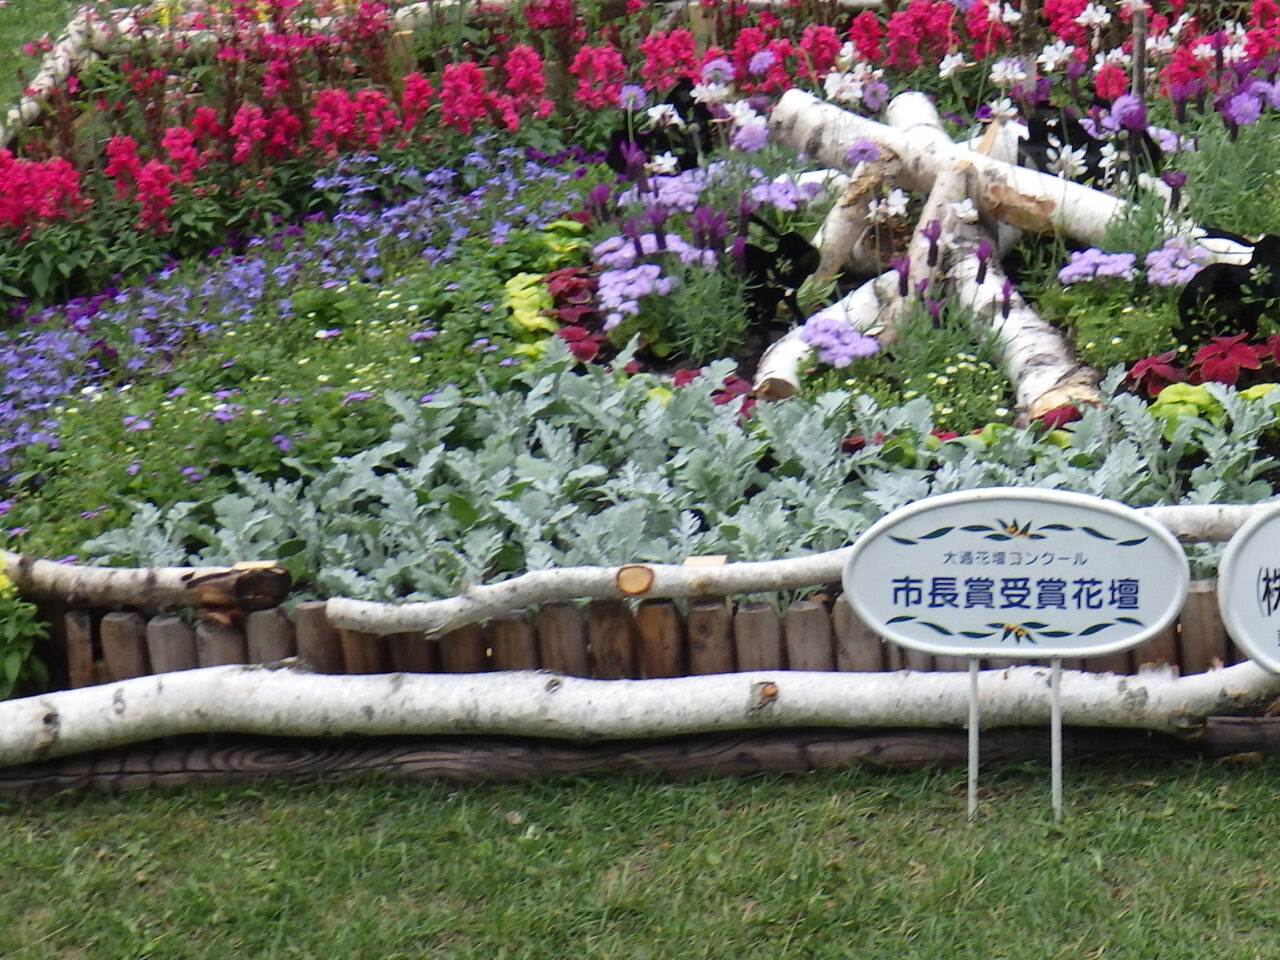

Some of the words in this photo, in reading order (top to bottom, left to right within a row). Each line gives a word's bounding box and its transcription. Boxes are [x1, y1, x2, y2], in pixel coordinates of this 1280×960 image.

[942, 550, 1089, 567] 大通花壇コンクール
[891, 575, 1140, 610] 市長賞受賞花壇
